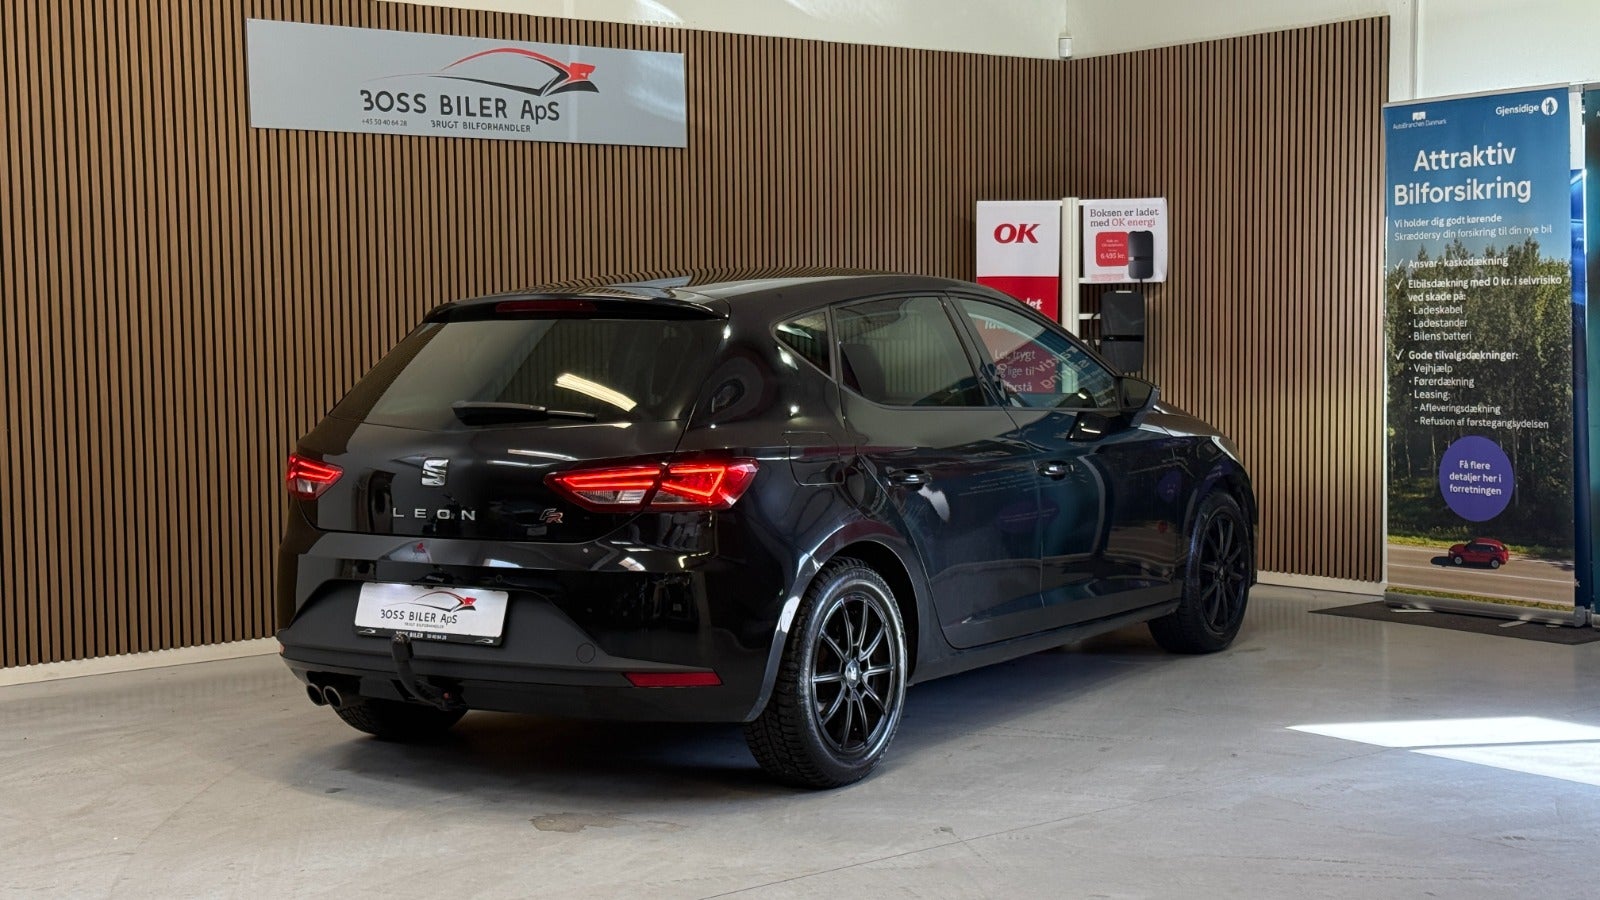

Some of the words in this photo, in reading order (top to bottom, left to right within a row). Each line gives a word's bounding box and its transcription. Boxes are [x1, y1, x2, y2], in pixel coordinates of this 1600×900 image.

[440, 94, 507, 119] BILER
[520, 99, 560, 124] ApS
[1495, 103, 1540, 117] Gjensidige
[462, 121, 531, 133] BILFORHANDLER
[1413, 142, 1516, 172] Attraktiv
[1394, 176, 1531, 206] Bilforsikring
[1090, 209, 1122, 218] Boksen
[1136, 208, 1160, 217] ladet
[1090, 218, 1109, 227] med
[1111, 218, 1125, 227] OK
[1127, 217, 1156, 227] energi
[1394, 220, 1402, 228] Vi
[1403, 218, 1429, 228] holder
[1431, 217, 1444, 229] dig
[1446, 216, 1465, 228] godt
[1467, 214, 1502, 224] kørende
[993, 223, 1041, 244] OK
[1394, 230, 1440, 241] Skræddersy
[1442, 229, 1456, 238] din
[1457, 227, 1496, 239] forsikring
[1498, 226, 1507, 236] til
[1509, 225, 1522, 235] din
[1523, 227, 1539, 237] nye
[1541, 224, 1553, 234] bil
[1444, 256, 1509, 268] kaskodækning
[1408, 278, 1469, 290] Elbilsdækning
[1470, 278, 1490, 287] med
[1492, 277, 1499, 286] 0
[1501, 276, 1513, 286] kr.
[1518, 275, 1562, 285] selvrisiko
[1408, 292, 1424, 302] ved
[1425, 291, 1452, 301] skade
[1453, 291, 1466, 303] på:
[1413, 305, 1463, 315] Ladeskabel
[1413, 319, 1468, 328] Ladestander
[1413, 332, 1441, 341] Bilens
[1443, 331, 1472, 341] batteri
[1408, 351, 1432, 360] Gode
[1434, 350, 1518, 362] tilvalgsdækninger:
[1413, 364, 1453, 375] Vejhjælp
[1414, 377, 1475, 388] Førerdækning
[1419, 403, 1501, 416] Afleveringsdækning
[1419, 417, 1455, 426] Refusion
[1456, 417, 1465, 426] af
[1466, 418, 1549, 430] førstegangsydelsen
[1459, 460, 1469, 469] Få
[1470, 460, 1491, 470] flere
[1449, 472, 1481, 483] detaljer
[1482, 473, 1497, 483] her
[1449, 484, 1502, 497] forretningen
[392, 507, 476, 521] LEON
[409, 611, 436, 623] BILER
[441, 613, 458, 626] ApS
